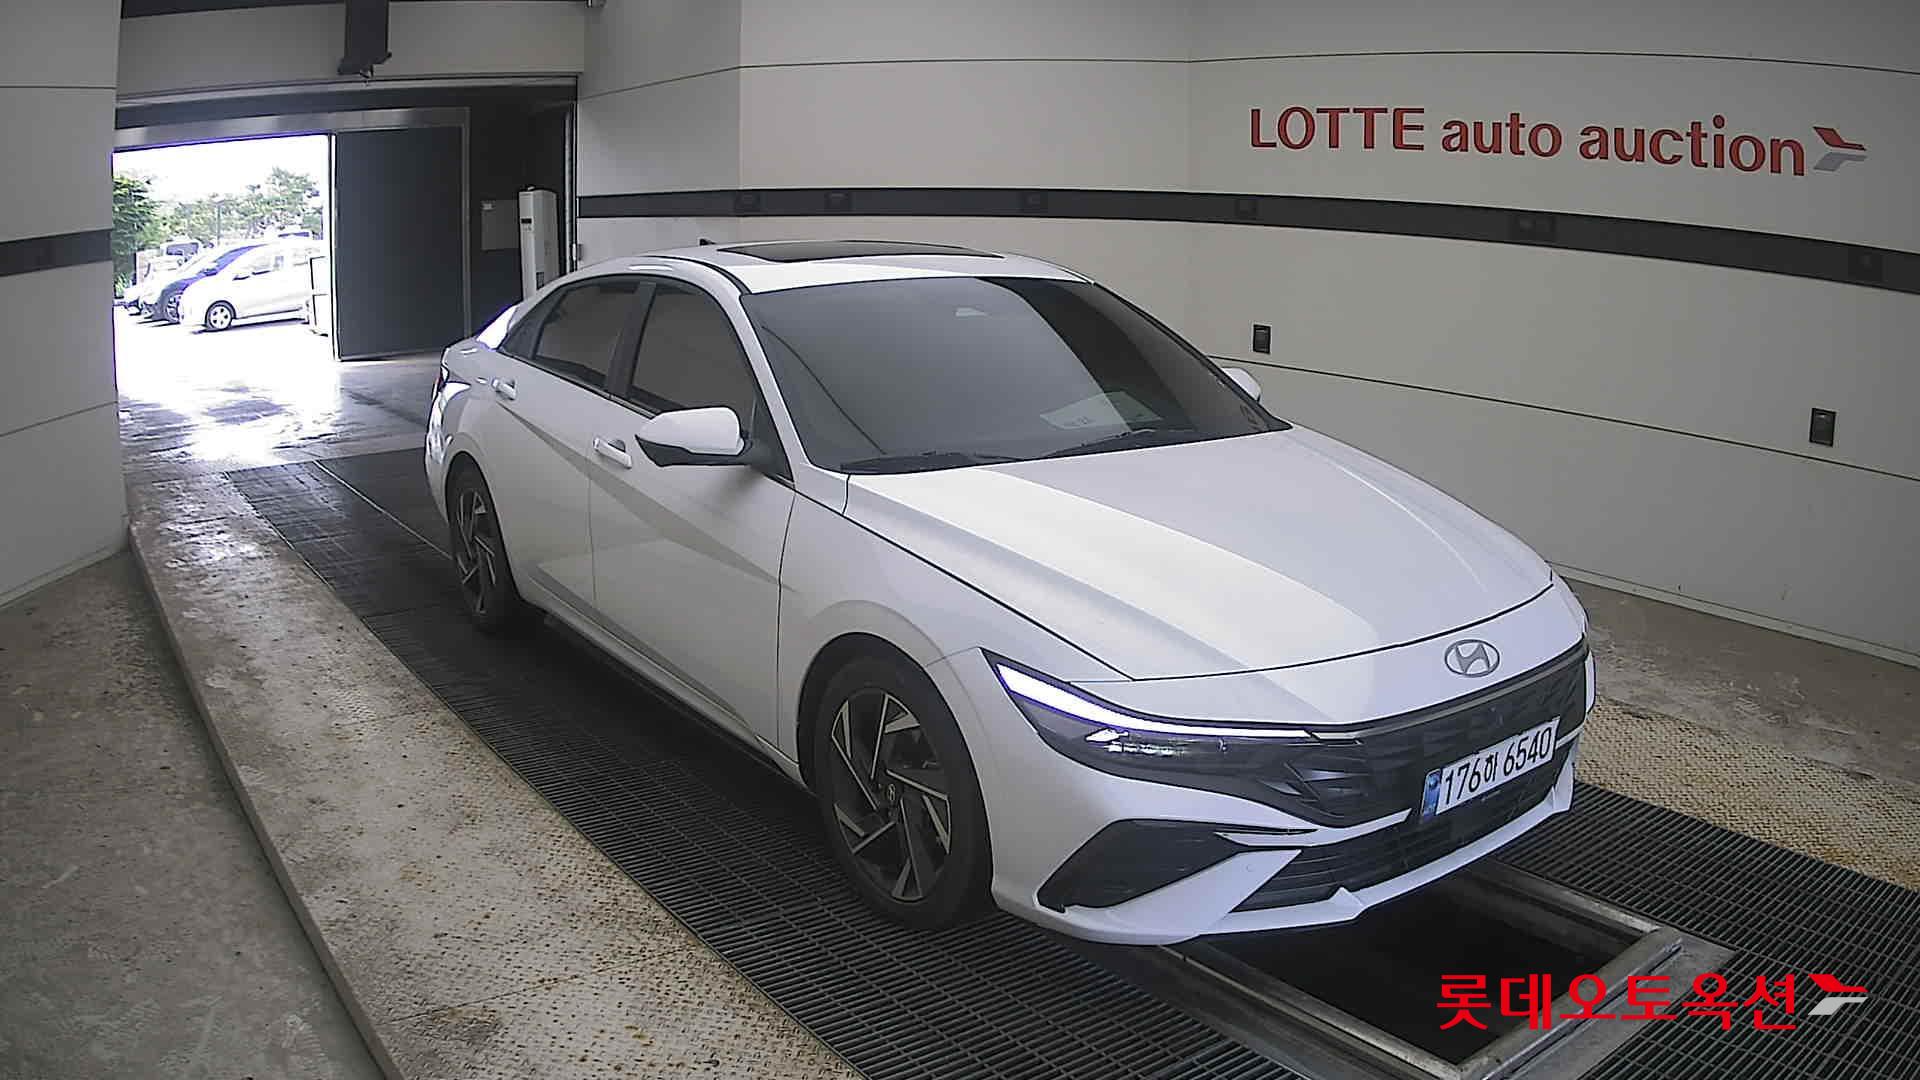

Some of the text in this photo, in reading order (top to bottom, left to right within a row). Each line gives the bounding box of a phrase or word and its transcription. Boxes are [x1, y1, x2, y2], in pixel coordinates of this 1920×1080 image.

[1250, 105, 1806, 177] LOTTE auto auction
[1444, 727, 1553, 805] 176하 6540
